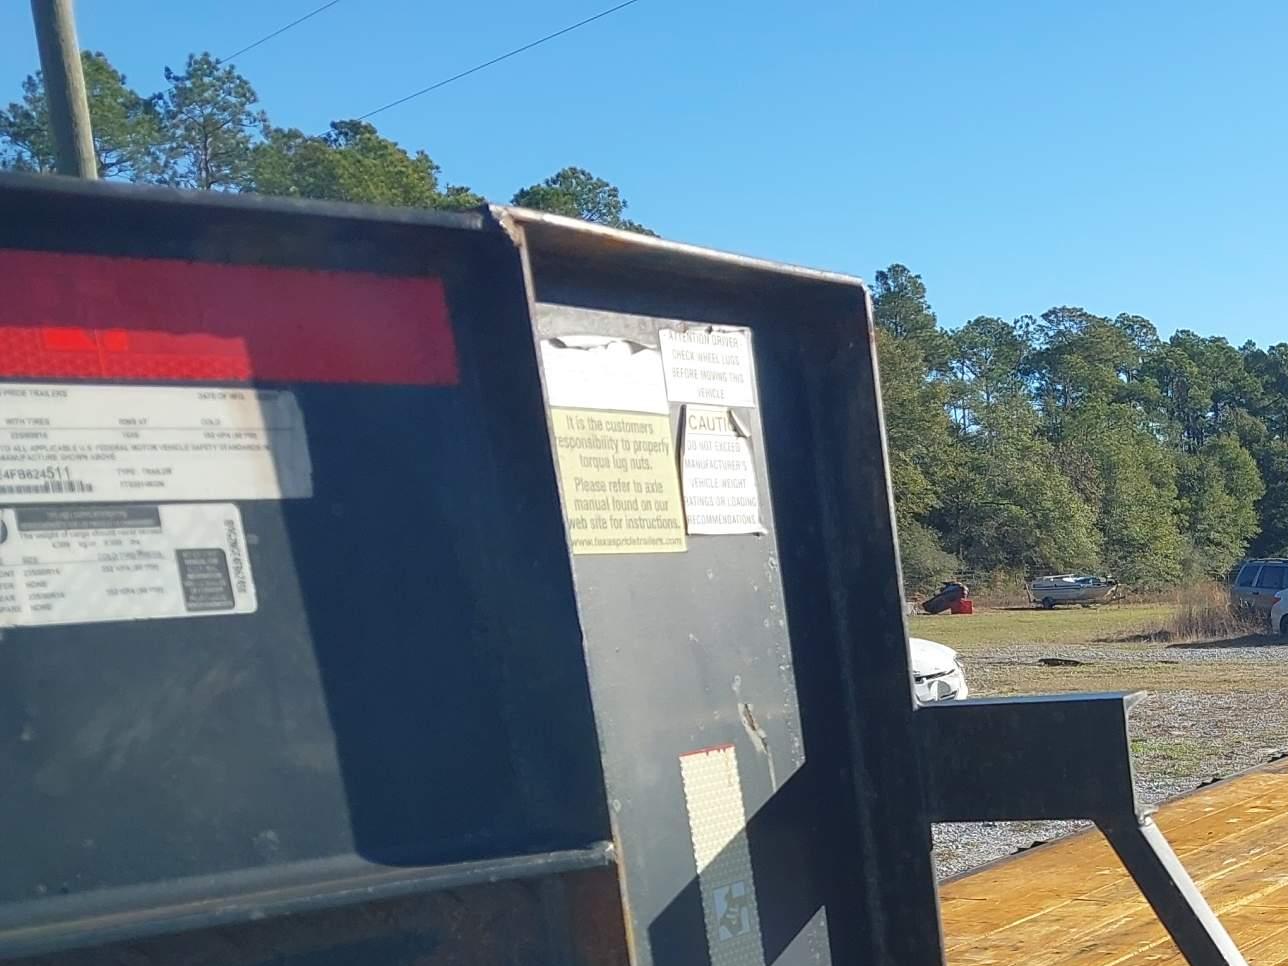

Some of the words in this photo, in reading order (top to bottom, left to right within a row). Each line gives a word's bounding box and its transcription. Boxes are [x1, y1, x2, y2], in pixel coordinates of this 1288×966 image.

[669, 331, 710, 345] ATTENTION
[712, 334, 738, 347] DRIVER
[672, 349, 694, 360] CHECK
[697, 351, 720, 363] WHEEL
[672, 367, 697, 379] BEFORE
[700, 370, 727, 382] MOVING
[729, 372, 744, 383] THIS
[698, 387, 725, 399] VEHICLE
[566, 415, 574, 430] It
[575, 416, 585, 430] is
[587, 416, 603, 431] the
[605, 420, 654, 434] customers
[688, 414, 732, 433] CAUTI
[555, 434, 619, 453] responsibility
[621, 439, 631, 450] to
[633, 439, 670, 456] properly
[699, 440, 712, 451] NOT
[714, 441, 741, 453] EXCEED
[579, 455, 611, 472] torque
[612, 456, 628, 472] lug
[630, 457, 653, 471] nuts.
[574, 477, 607, 493] Please
[608, 478, 630, 493] refer
[633, 479, 643, 493] to
[645, 479, 664, 494] axle
[690, 478, 719, 489] VEHICLE
[721, 479, 747, 489] WEIGHT
[574, 497, 610, 512] manual
[612, 498, 639, 512] found
[640, 500, 652, 512] on
[654, 500, 669, 512] our
[727, 497, 757, 507] LOADING
[591, 516, 608, 530] site
[609, 516, 624, 530] for
[625, 516, 681, 530] instructions.
[687, 514, 757, 525] RECOMMENDATIONS
